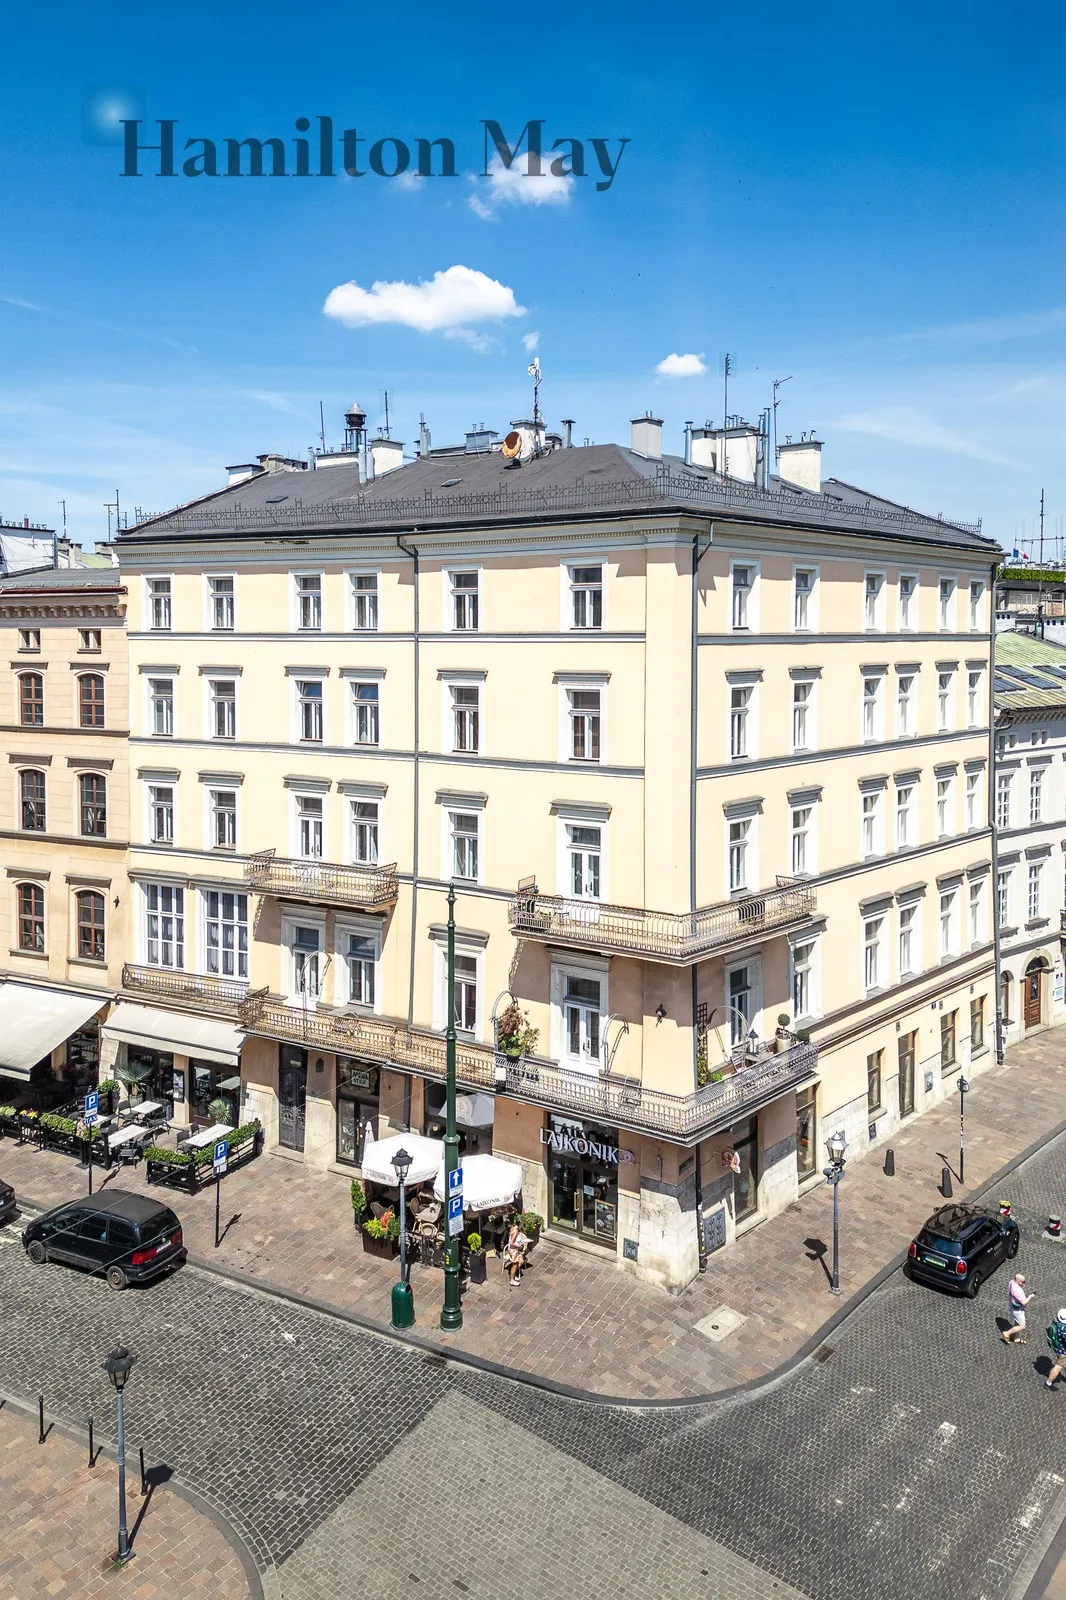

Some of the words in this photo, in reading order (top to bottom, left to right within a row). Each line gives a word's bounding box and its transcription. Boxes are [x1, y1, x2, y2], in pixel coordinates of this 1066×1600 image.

[88, 1095, 95, 1107] P
[217, 1144, 225, 1156] P
[539, 1127, 619, 1164] LAJKONIK
[452, 1197, 461, 1213] P
